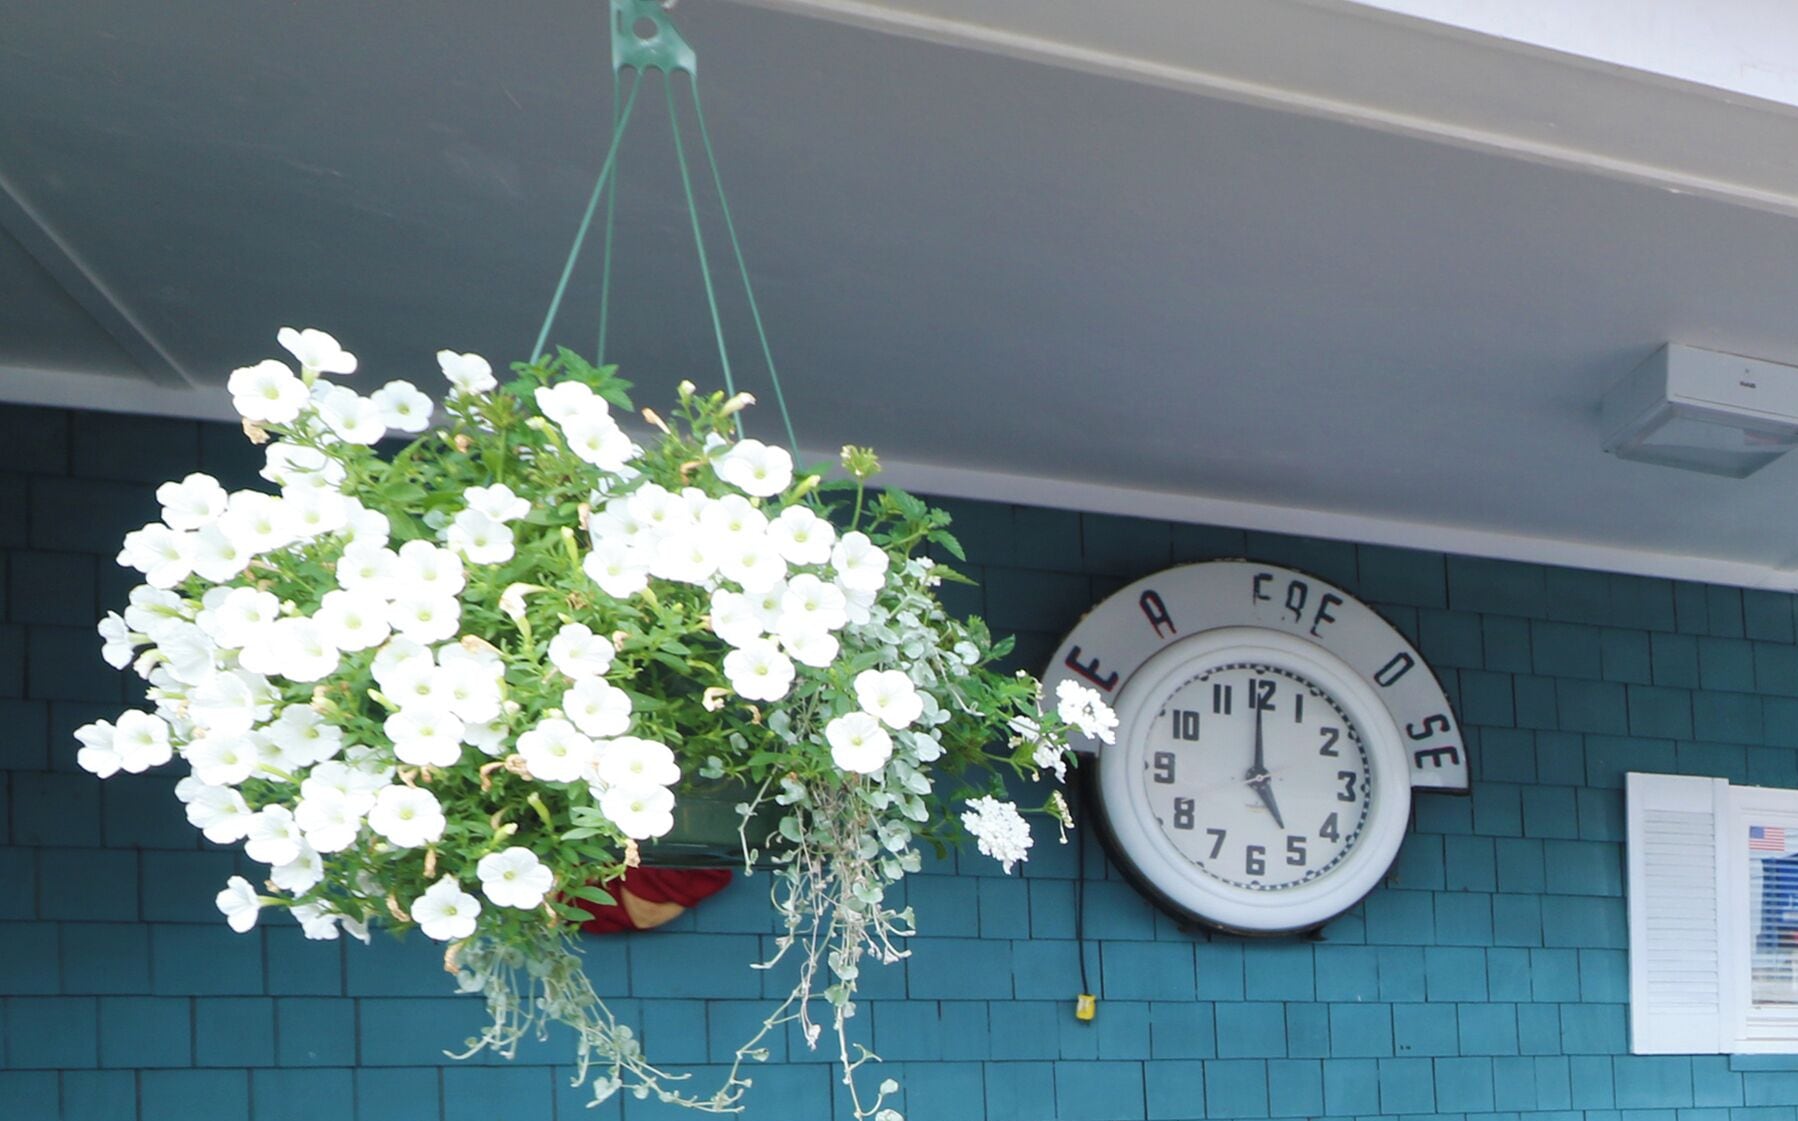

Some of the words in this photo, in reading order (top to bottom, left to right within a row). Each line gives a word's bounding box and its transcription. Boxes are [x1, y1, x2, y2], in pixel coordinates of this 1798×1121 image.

[1213, 684, 1232, 715] 11
[1249, 679, 1276, 711] 12
[1295, 694, 1303, 723] 1
[1172, 710, 1200, 741] 10
[1320, 727, 1340, 757] 2
[1153, 752, 1176, 784] 9
[1337, 771, 1356, 802] 3
[1173, 799, 1195, 830] 8
[1320, 813, 1340, 842] 4
[1206, 829, 1227, 859] 7
[1287, 836, 1306, 866] 5
[1246, 846, 1266, 876] 6
